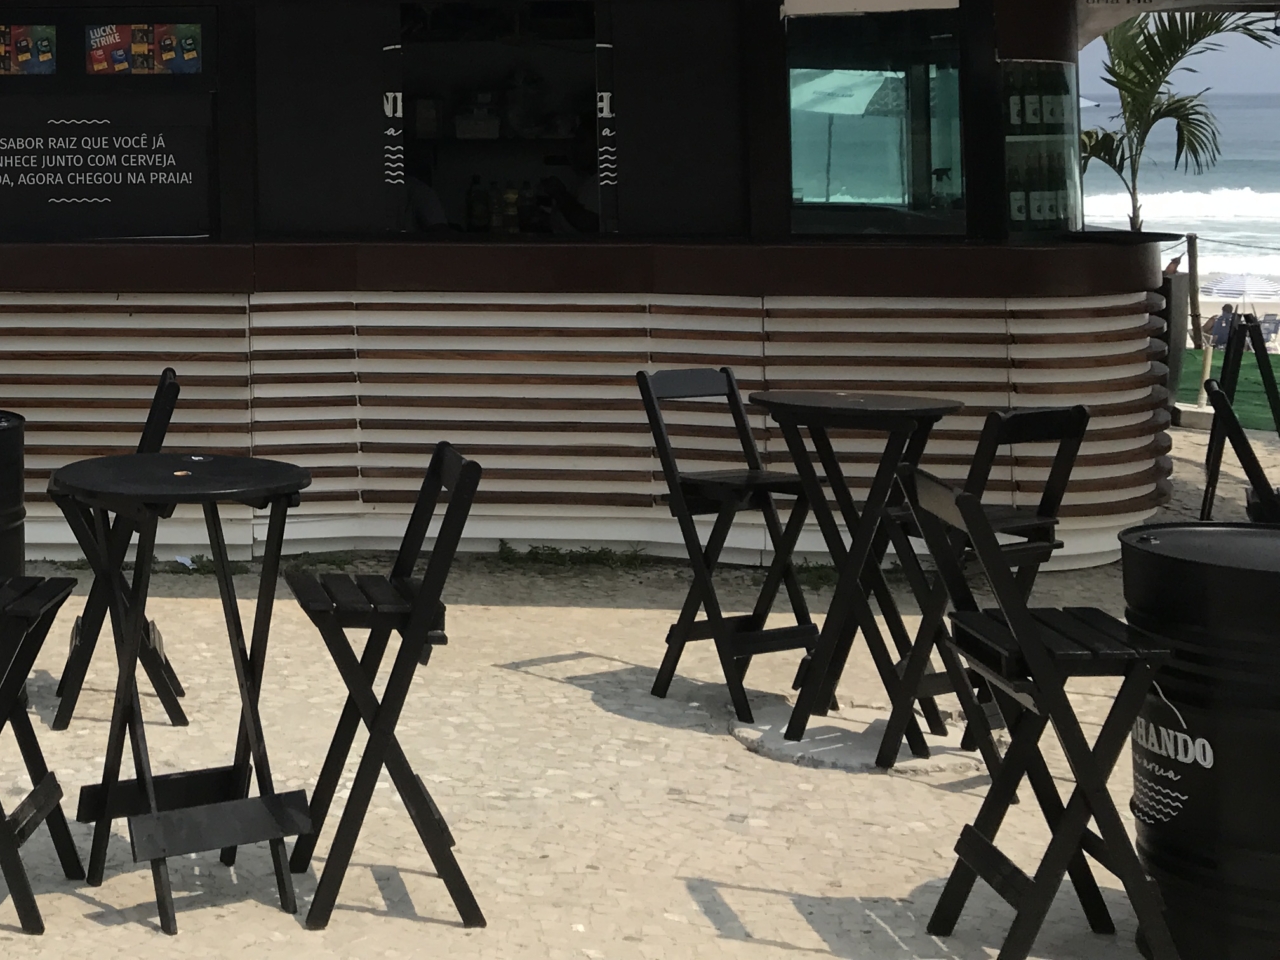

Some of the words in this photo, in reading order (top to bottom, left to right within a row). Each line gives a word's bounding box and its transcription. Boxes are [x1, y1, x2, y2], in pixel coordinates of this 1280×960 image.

[89, 24, 117, 39] LUCKY
[90, 32, 121, 49] STRIKE
[0, 137, 44, 150] SABOR
[48, 137, 78, 149] RAIZ
[81, 137, 109, 150] QUE
[112, 133, 148, 149] VOCÊ
[151, 133, 166, 150] JÁ
[41, 154, 84, 169] JUNTO
[87, 154, 117, 167] COM
[121, 154, 176, 167] CERVEJA
[17, 173, 64, 185] AGORA
[67, 172, 122, 185] CHEGOU
[127, 172, 146, 184] NA
[150, 172, 193, 184] PRAIA!
